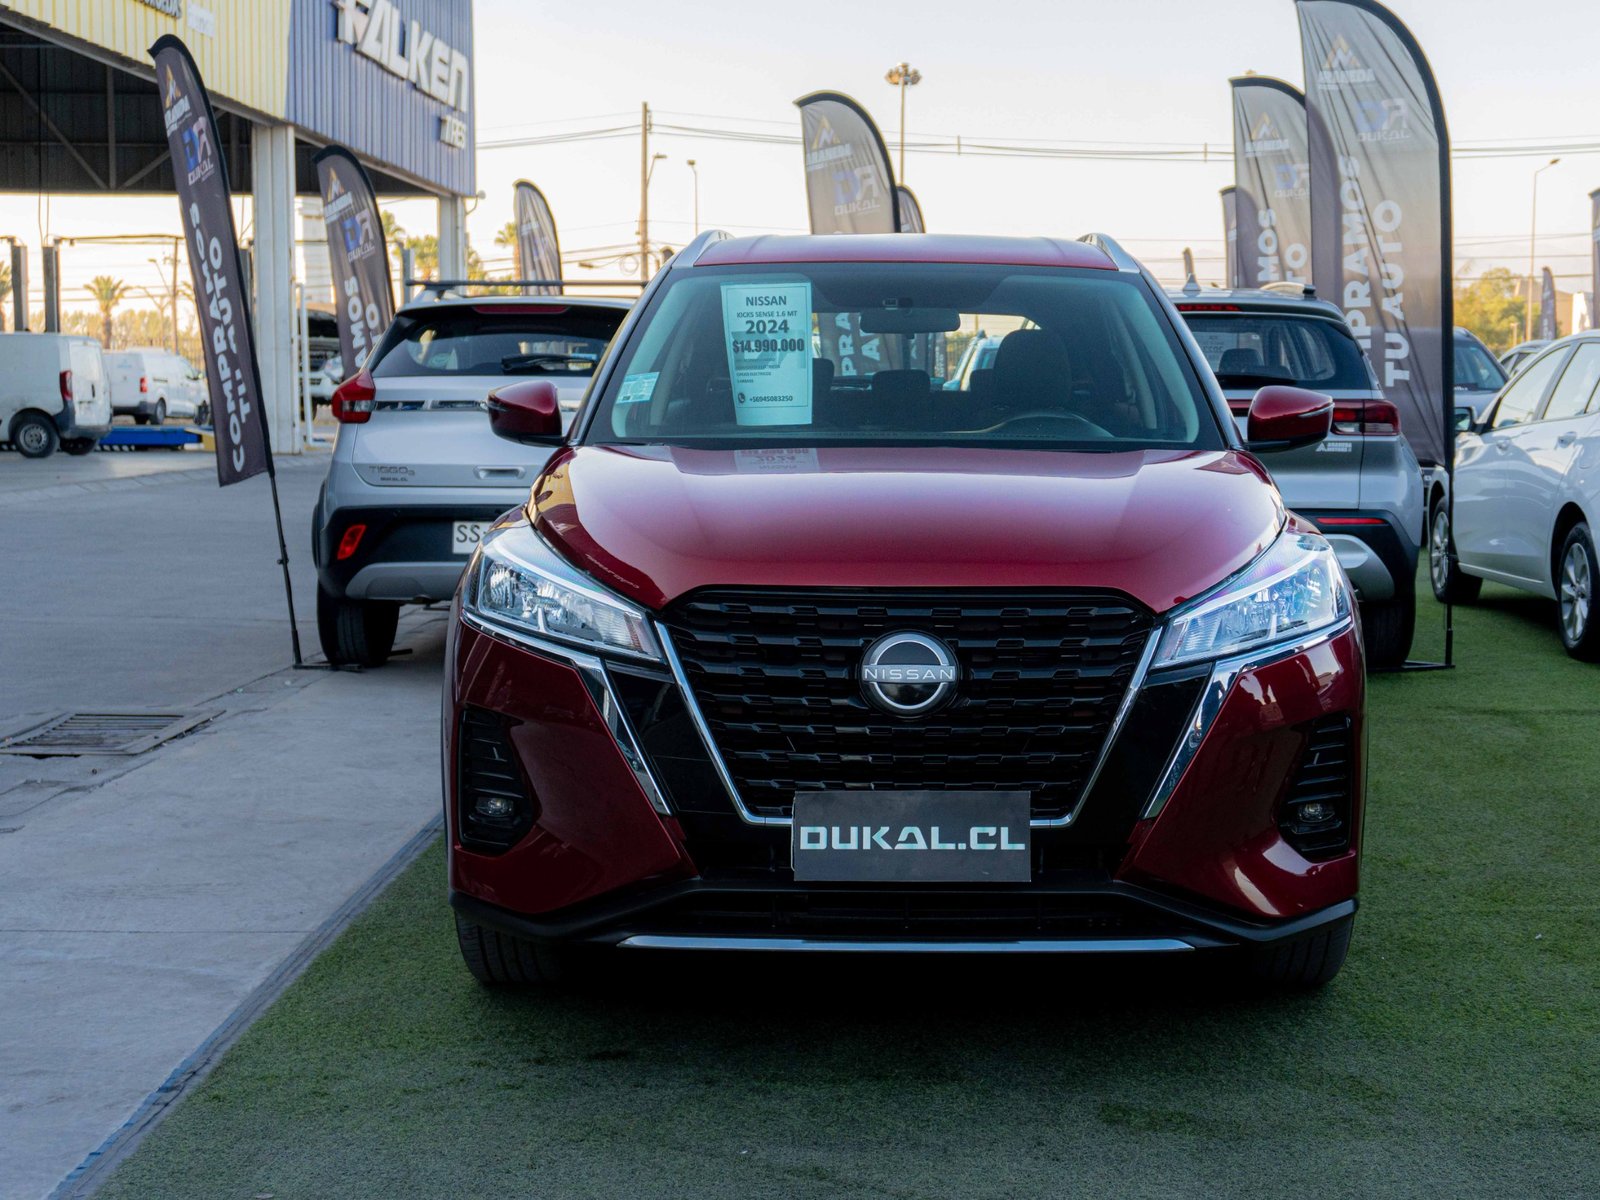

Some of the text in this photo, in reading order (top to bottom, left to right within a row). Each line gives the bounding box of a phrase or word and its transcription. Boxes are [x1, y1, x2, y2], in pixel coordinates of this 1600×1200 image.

[332, 0, 469, 113] FALKEN
[1257, 208, 1280, 282] MOS
[1338, 156, 1372, 350] PRAMOS
[745, 296, 787, 306] NISSAN
[1373, 200, 1410, 387] TU AUTO
[190, 202, 244, 473] COMPRAMOS
[732, 338, 805, 353] $14.990.000
[745, 319, 790, 334] 2024
[864, 668, 955, 680] NISSAN
[800, 826, 1026, 850] DUKAL.CL
